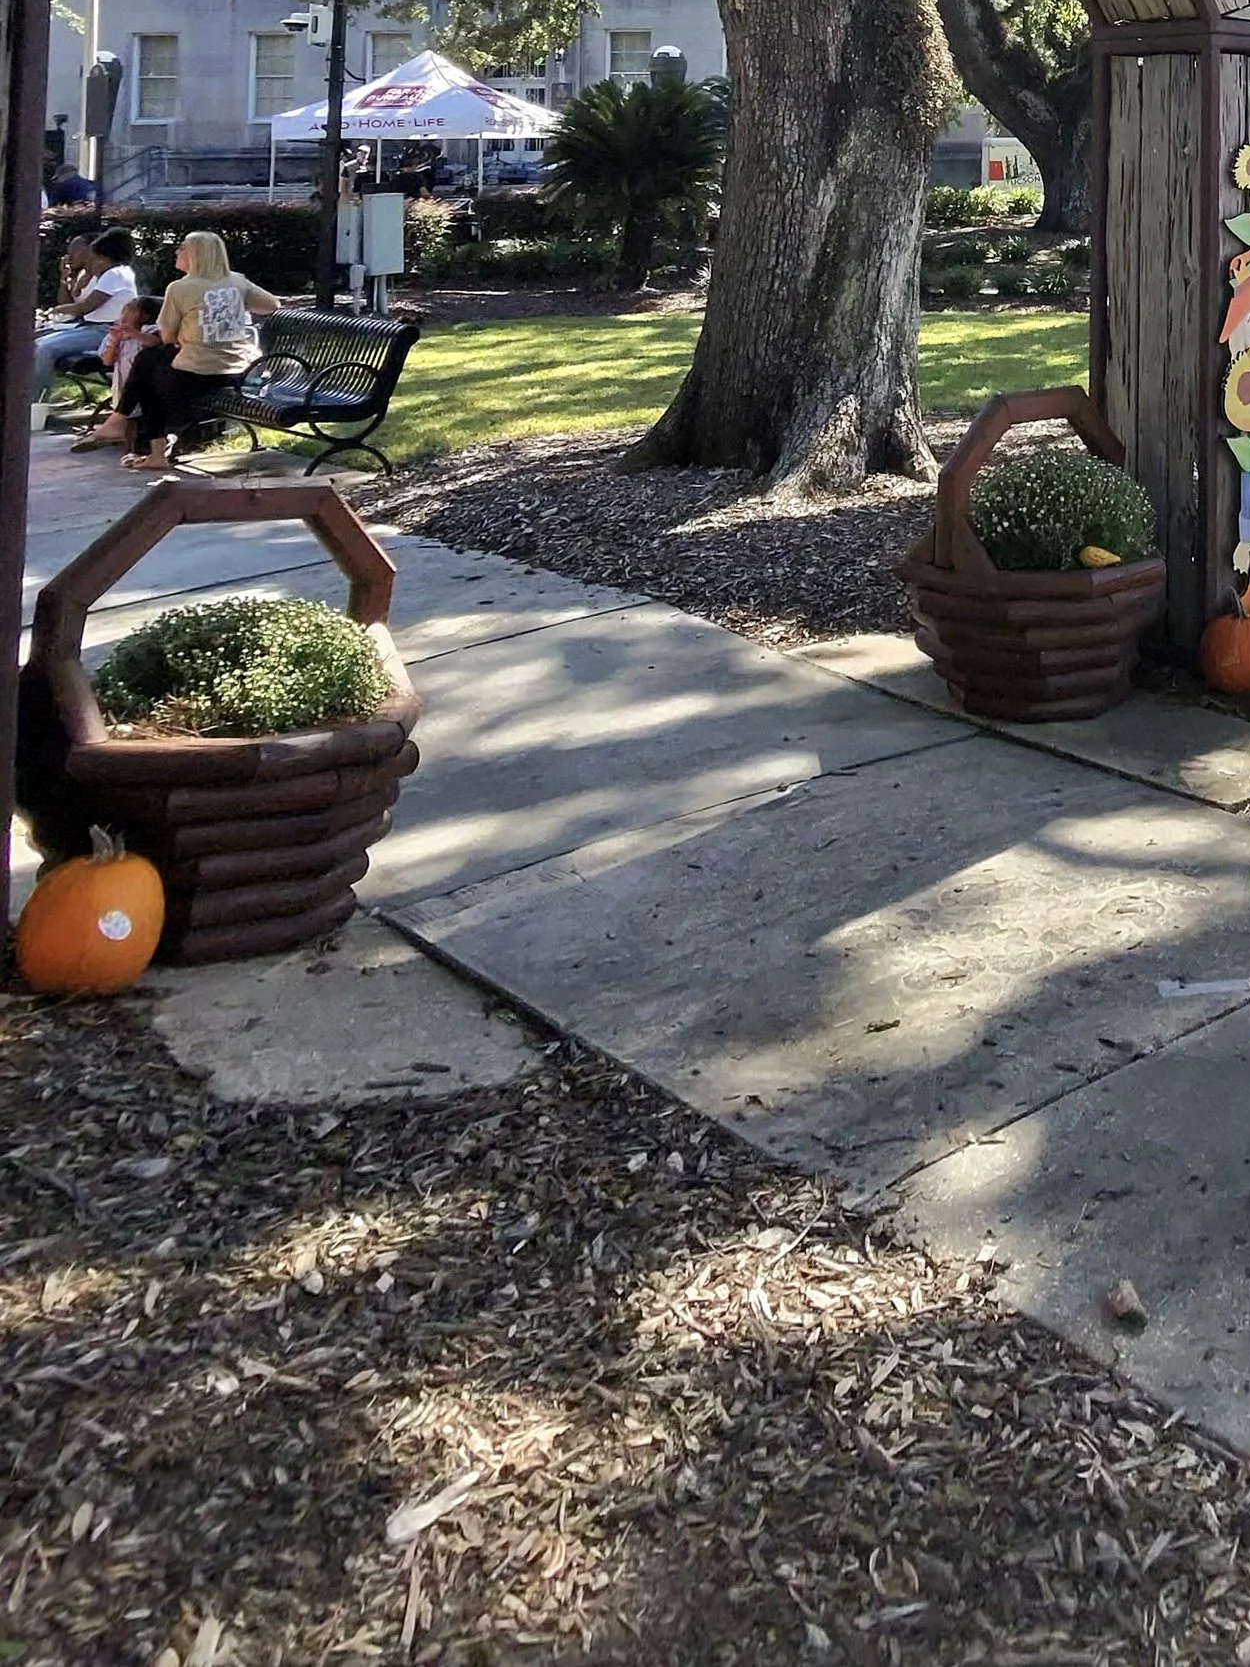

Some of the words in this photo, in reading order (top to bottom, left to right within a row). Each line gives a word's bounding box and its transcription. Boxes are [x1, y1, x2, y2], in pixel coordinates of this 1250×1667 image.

[308, 121, 350, 131] AO
[359, 119, 405, 129] HOME
[414, 117, 445, 127] LIFE
